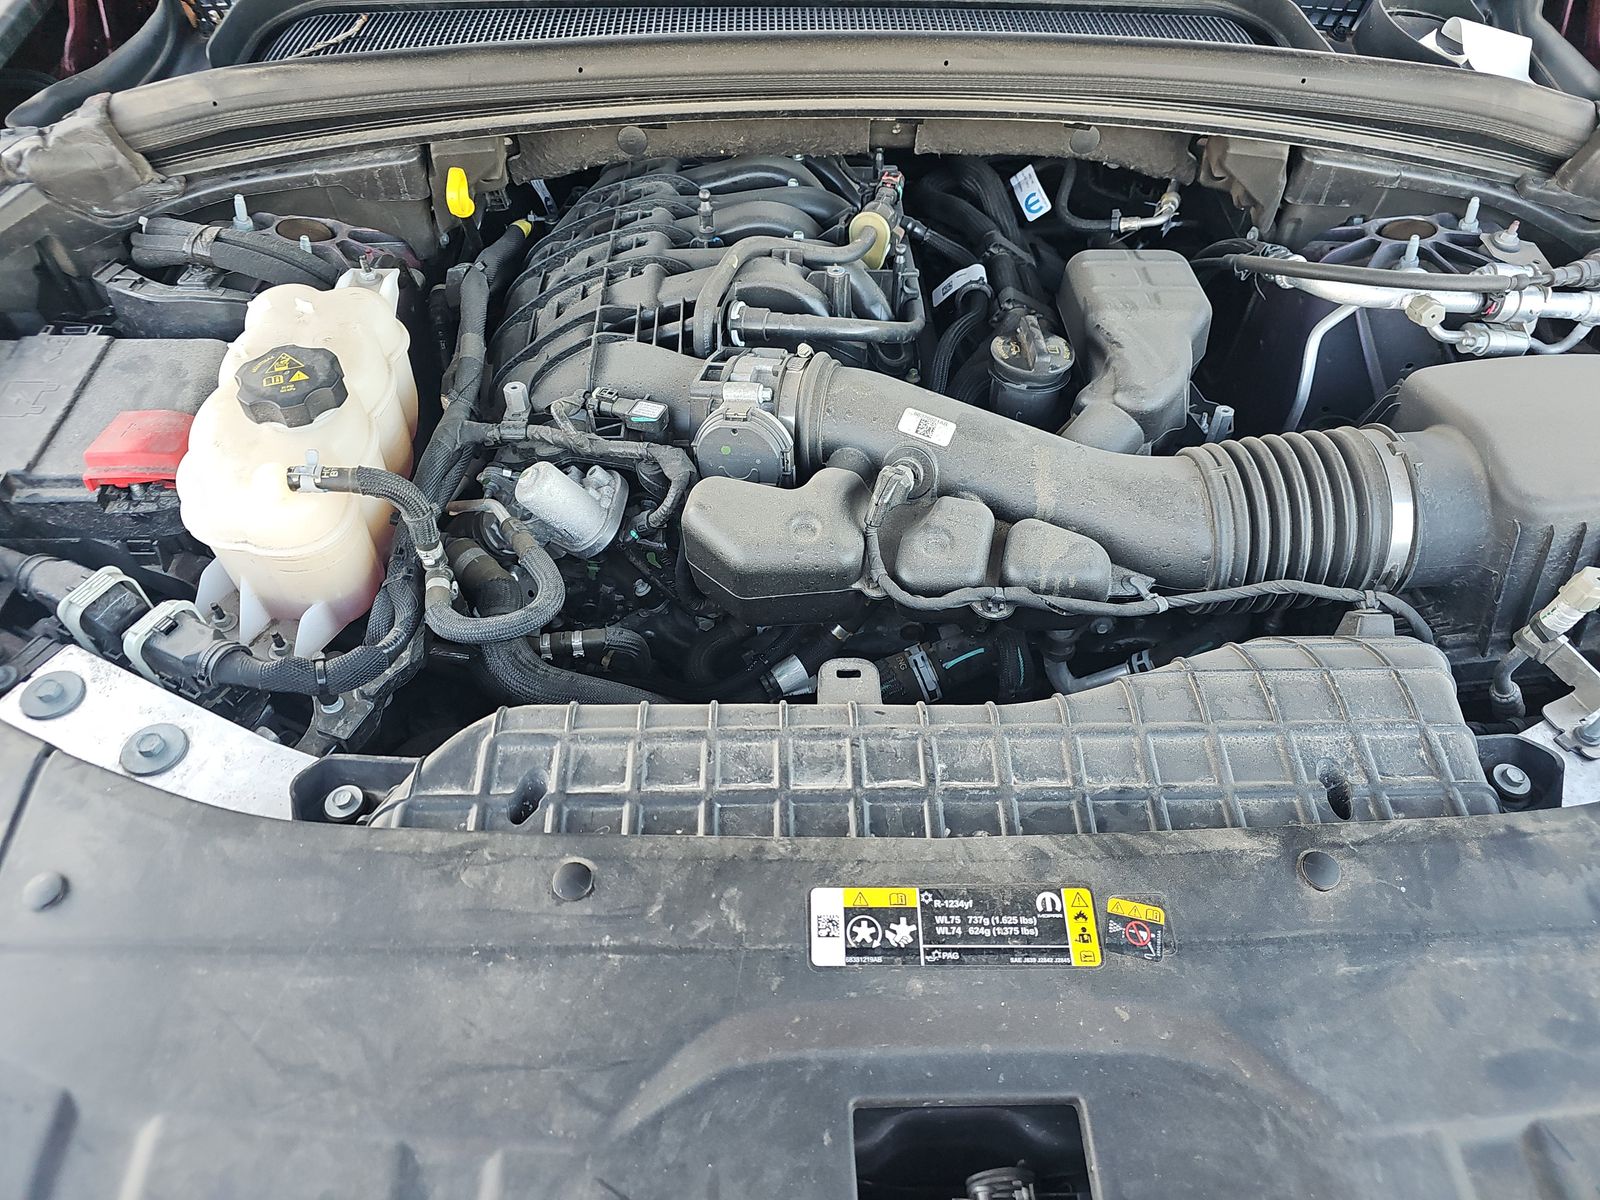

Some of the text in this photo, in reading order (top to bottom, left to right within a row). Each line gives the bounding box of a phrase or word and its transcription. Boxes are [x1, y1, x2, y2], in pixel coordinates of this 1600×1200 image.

[934, 900, 973, 910] R-1234yf
[935, 916, 1037, 926] WL75 737g (1.625 lbs)
[936, 927, 1039, 937] WL74 624g (1.375 lbs)
[942, 952, 960, 960] PAG
